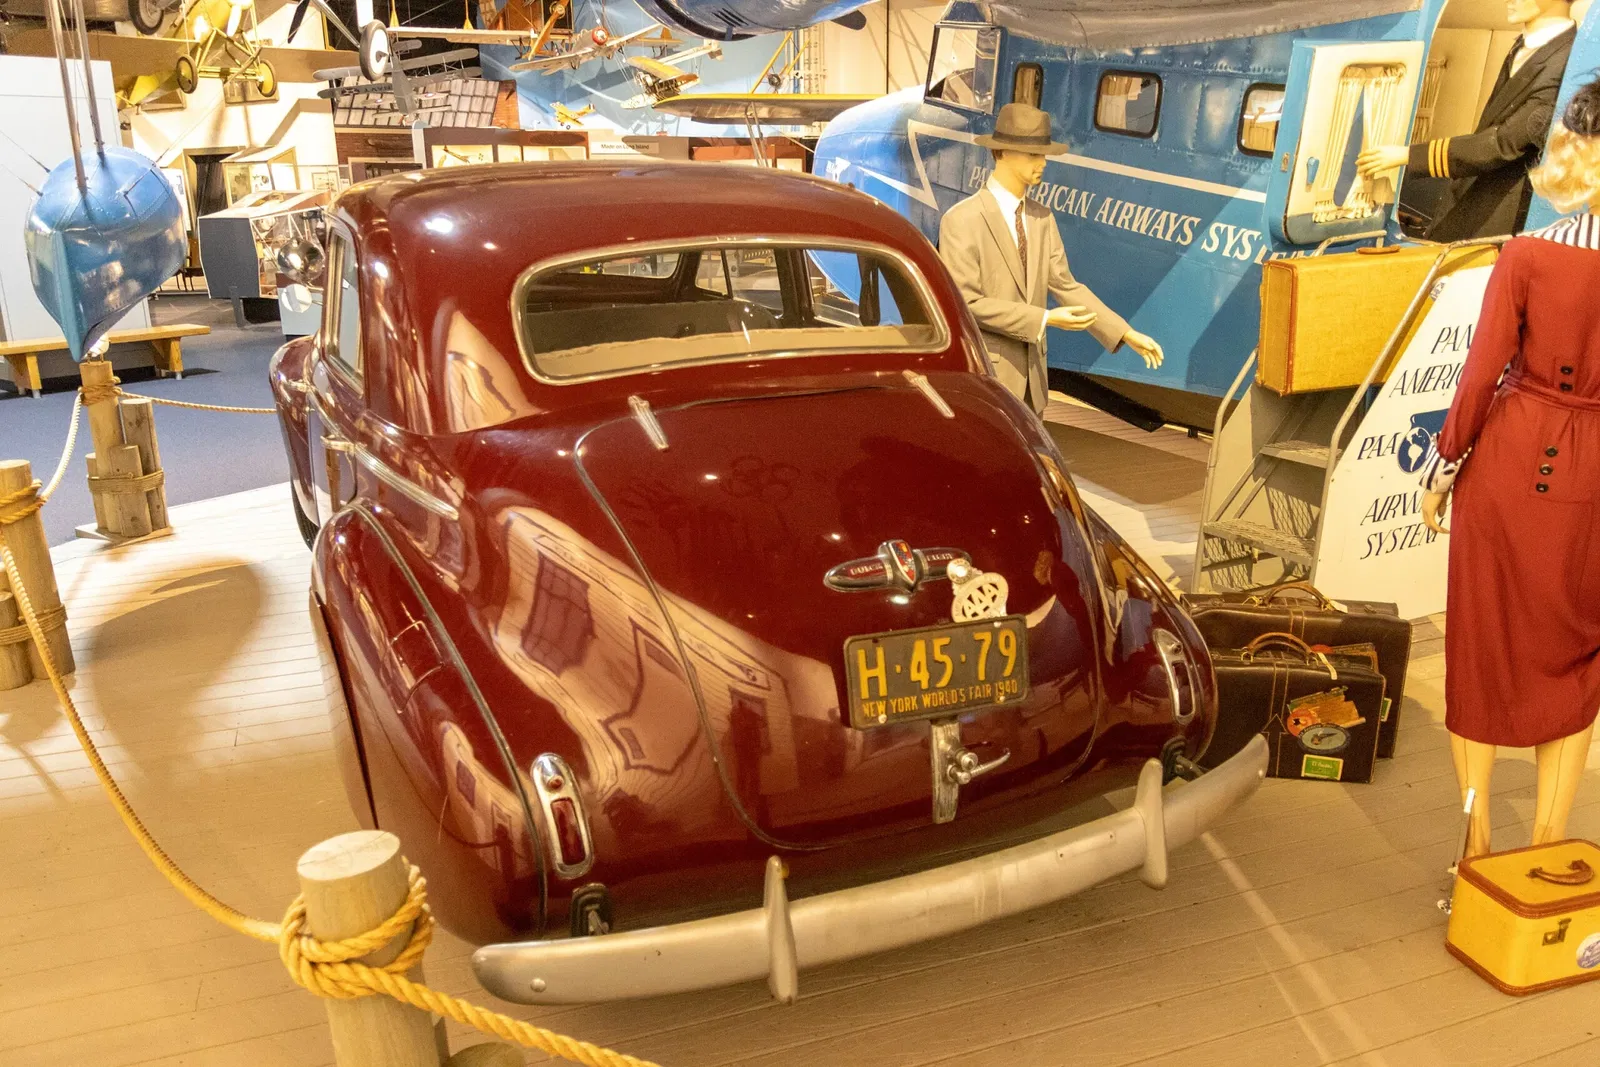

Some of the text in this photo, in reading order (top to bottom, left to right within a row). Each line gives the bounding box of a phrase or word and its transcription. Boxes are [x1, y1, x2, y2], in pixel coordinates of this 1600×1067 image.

[1094, 197, 1202, 246] AIRWAYS
[1357, 432, 1402, 460] PAA
[962, 583, 999, 617] AAA
[862, 700, 887, 718] NEW
[890, 696, 919, 714] YORK
[969, 684, 992, 700] FAIR
[995, 679, 1018, 697] 1940
